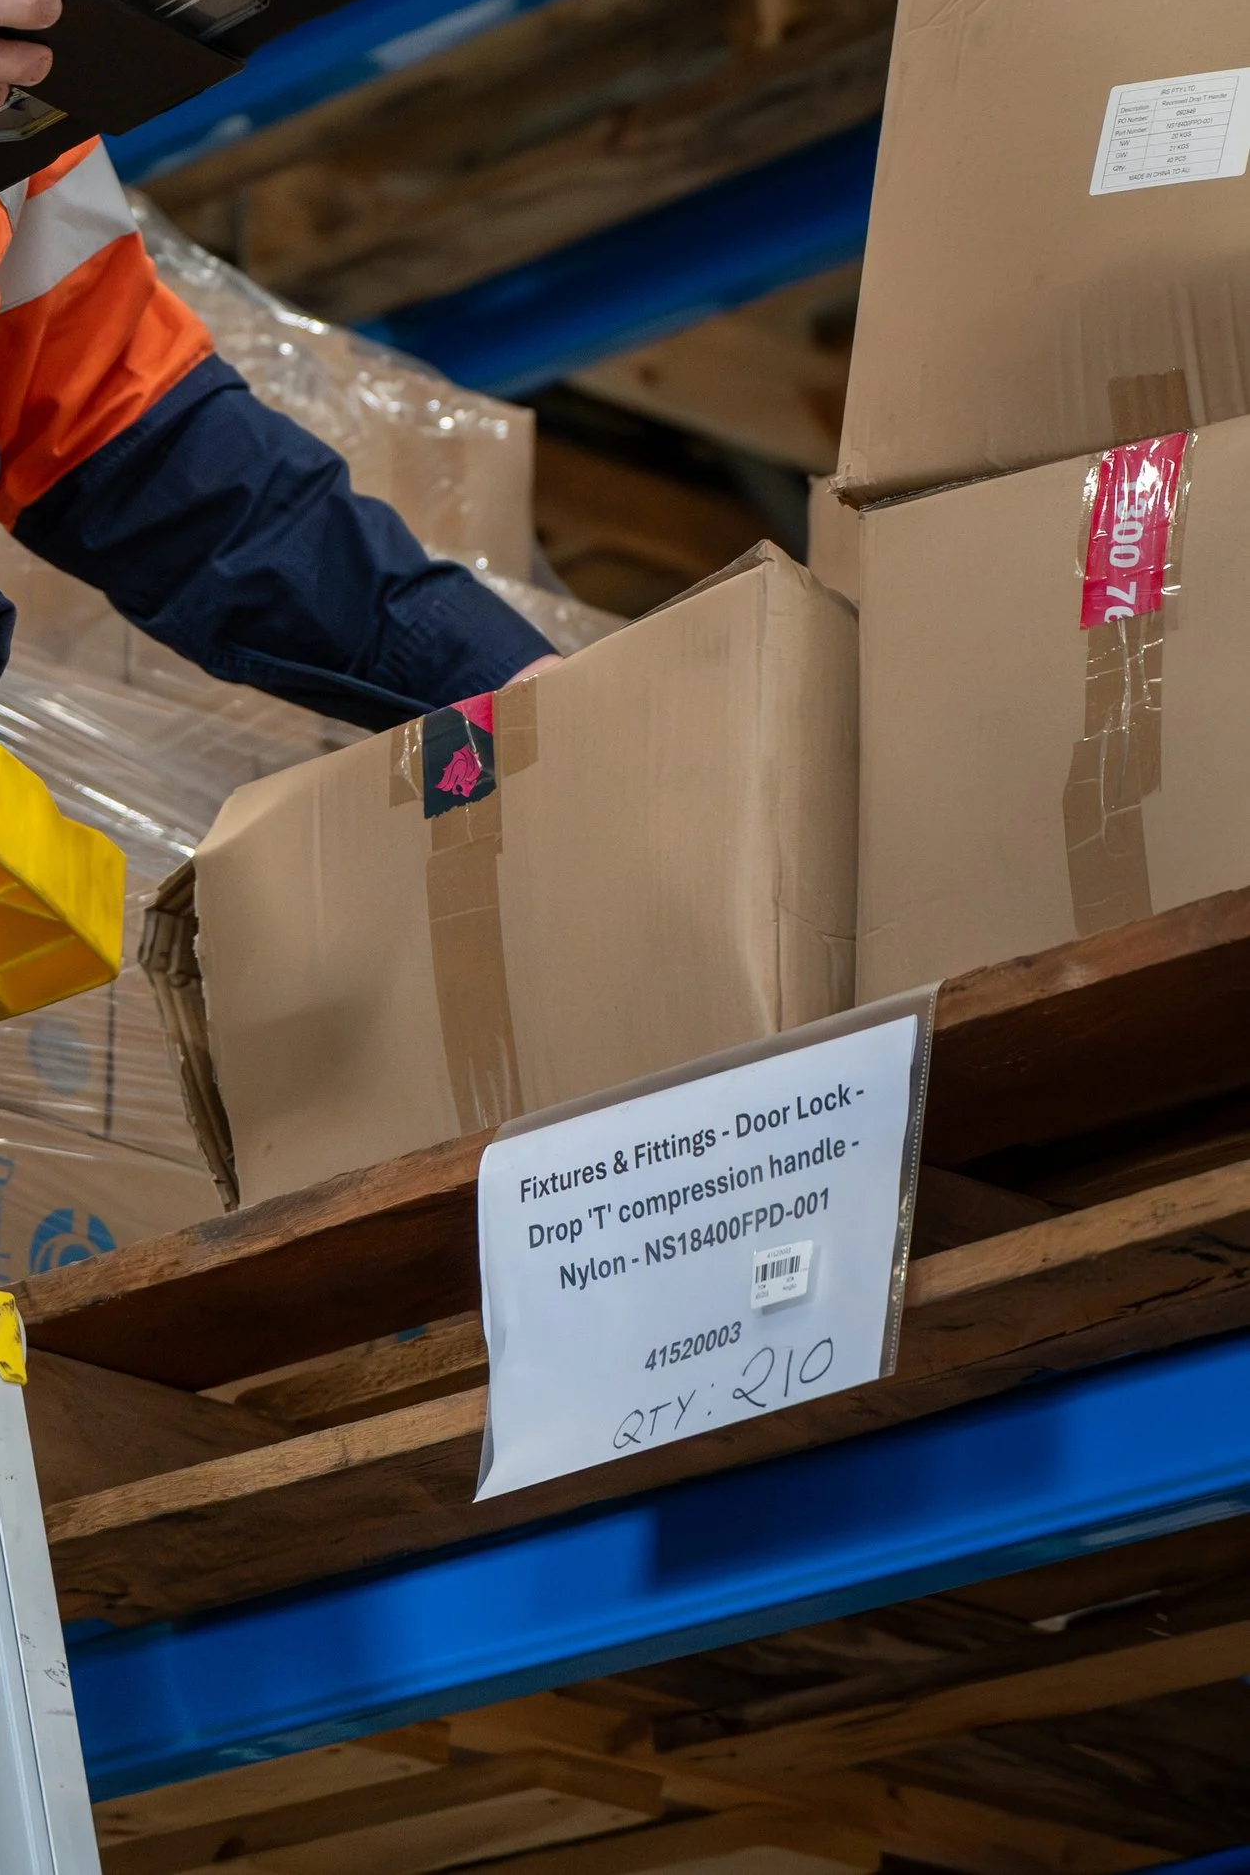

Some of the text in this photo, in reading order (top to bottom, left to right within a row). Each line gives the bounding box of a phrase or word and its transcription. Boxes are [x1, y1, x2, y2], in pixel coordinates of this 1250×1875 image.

[520, 1161, 607, 1203] Fixtures
[613, 1150, 629, 1175] &
[634, 1128, 716, 1169] Fittings
[735, 1105, 790, 1138] Door
[796, 1083, 851, 1120] Lock
[529, 1218, 583, 1249] Drop
[587, 1202, 612, 1230] 'T'
[618, 1164, 764, 1223] compression
[769, 1137, 846, 1179] handle
[559, 1254, 626, 1291] Nylon
[644, 1187, 829, 1266] NS18400FPD-001
[645, 1321, 742, 1371] 41520003
[732, 1337, 834, 1408] 210
